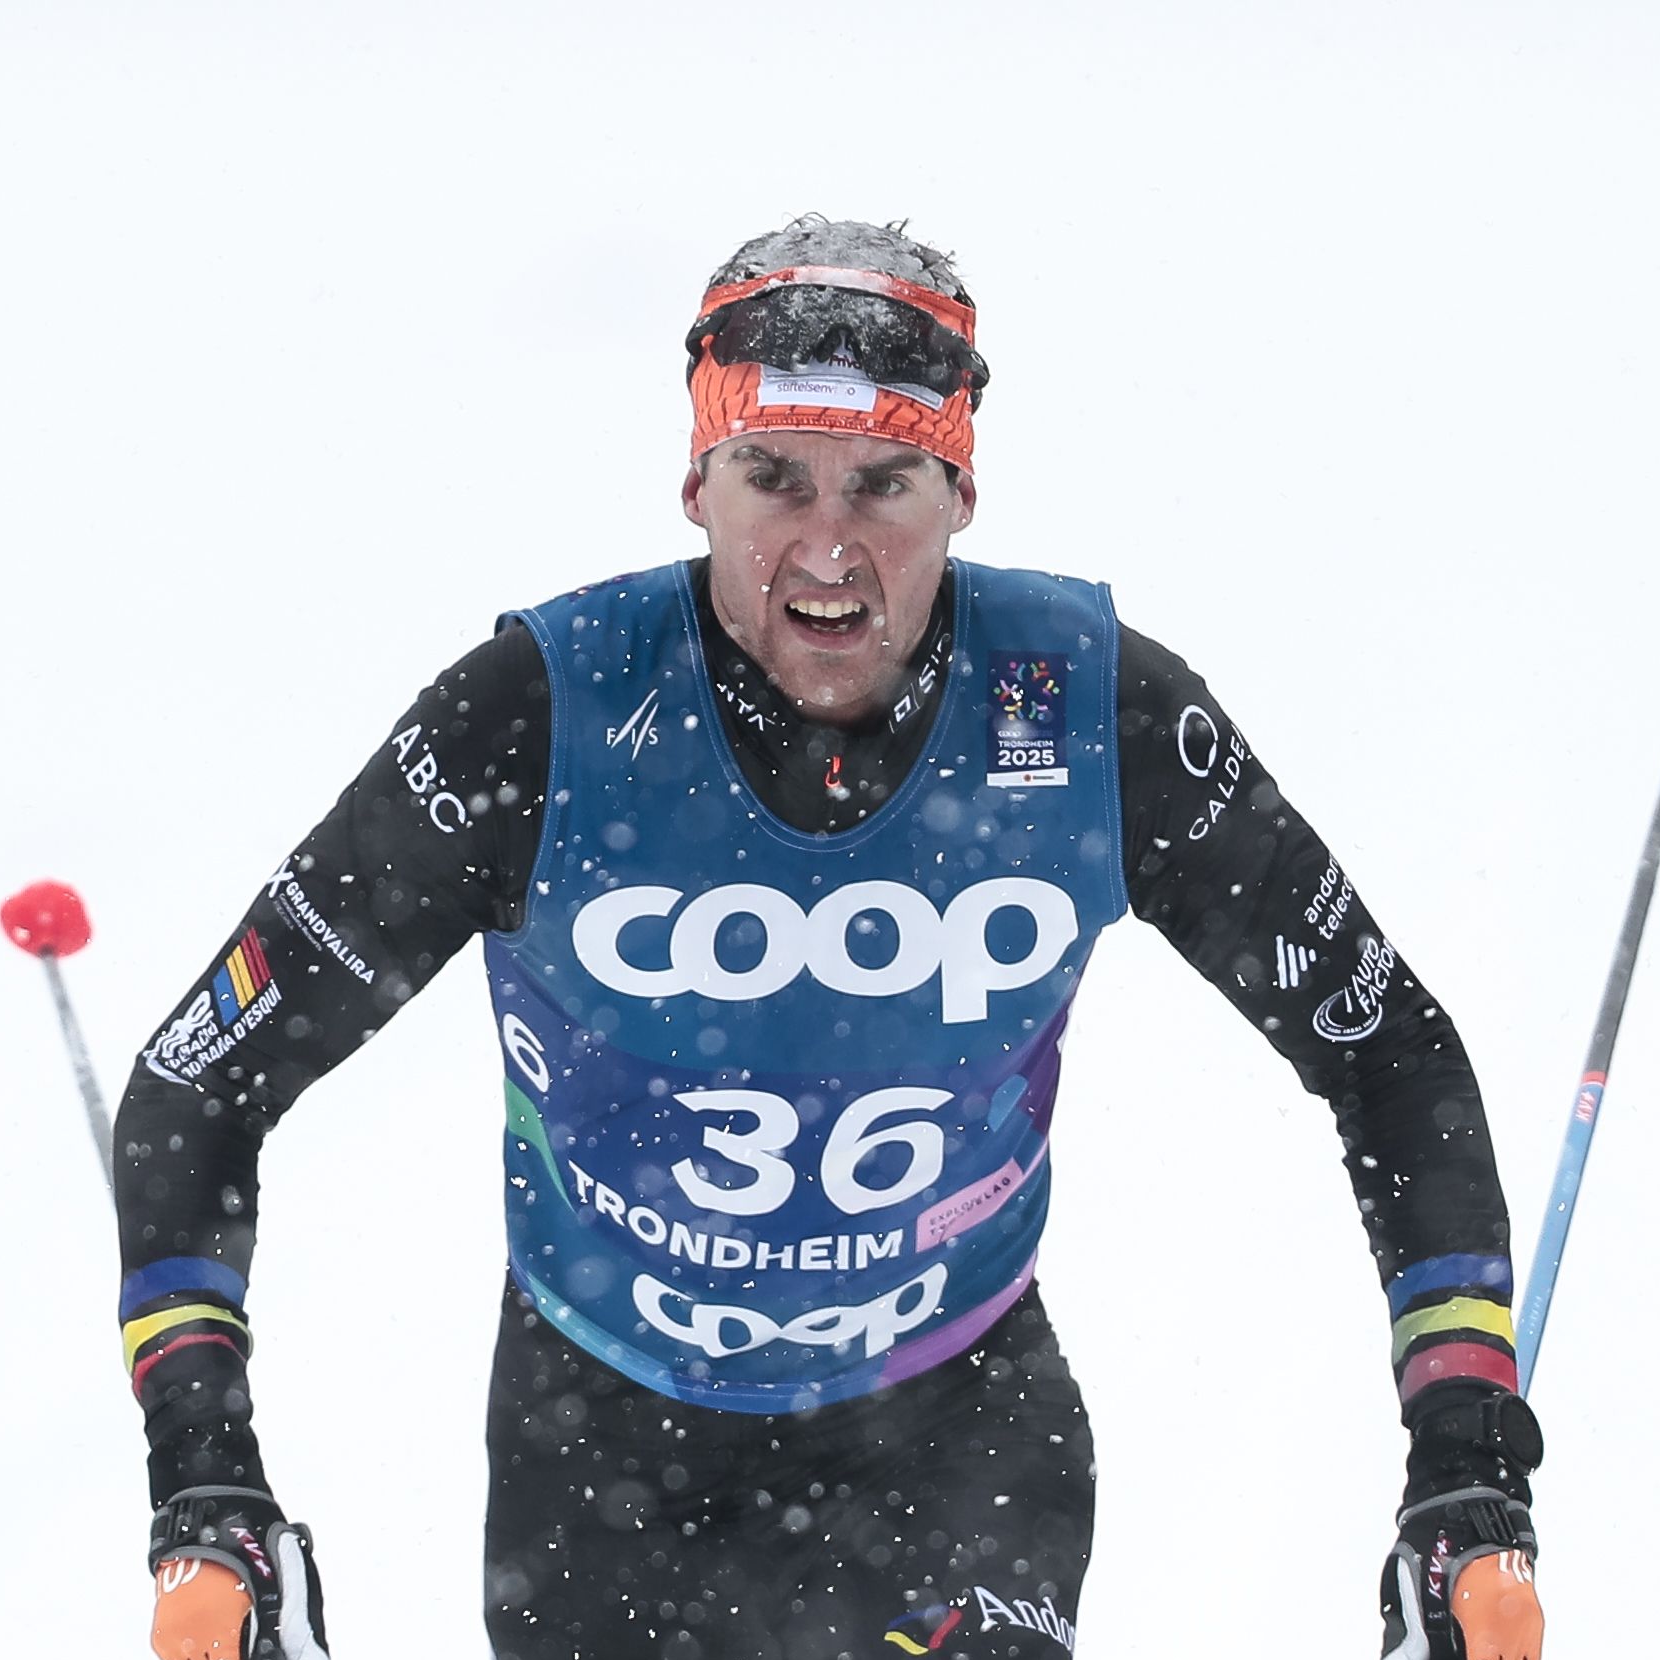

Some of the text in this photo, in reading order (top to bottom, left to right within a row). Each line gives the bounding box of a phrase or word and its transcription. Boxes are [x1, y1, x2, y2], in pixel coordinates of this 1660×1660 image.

[997, 740, 1054, 748] TRONDHEIM
[997, 749, 1055, 766] 2025
[1188, 723, 1246, 840] CALDE
[285, 881, 376, 985] GRANDVALIRA
[572, 876, 1079, 1024] coop
[1351, 937, 1380, 997] AUTO
[670, 1086, 956, 1216] 36
[568, 1159, 904, 1271] TRONDHEIM
[632, 1263, 949, 1358] coop
